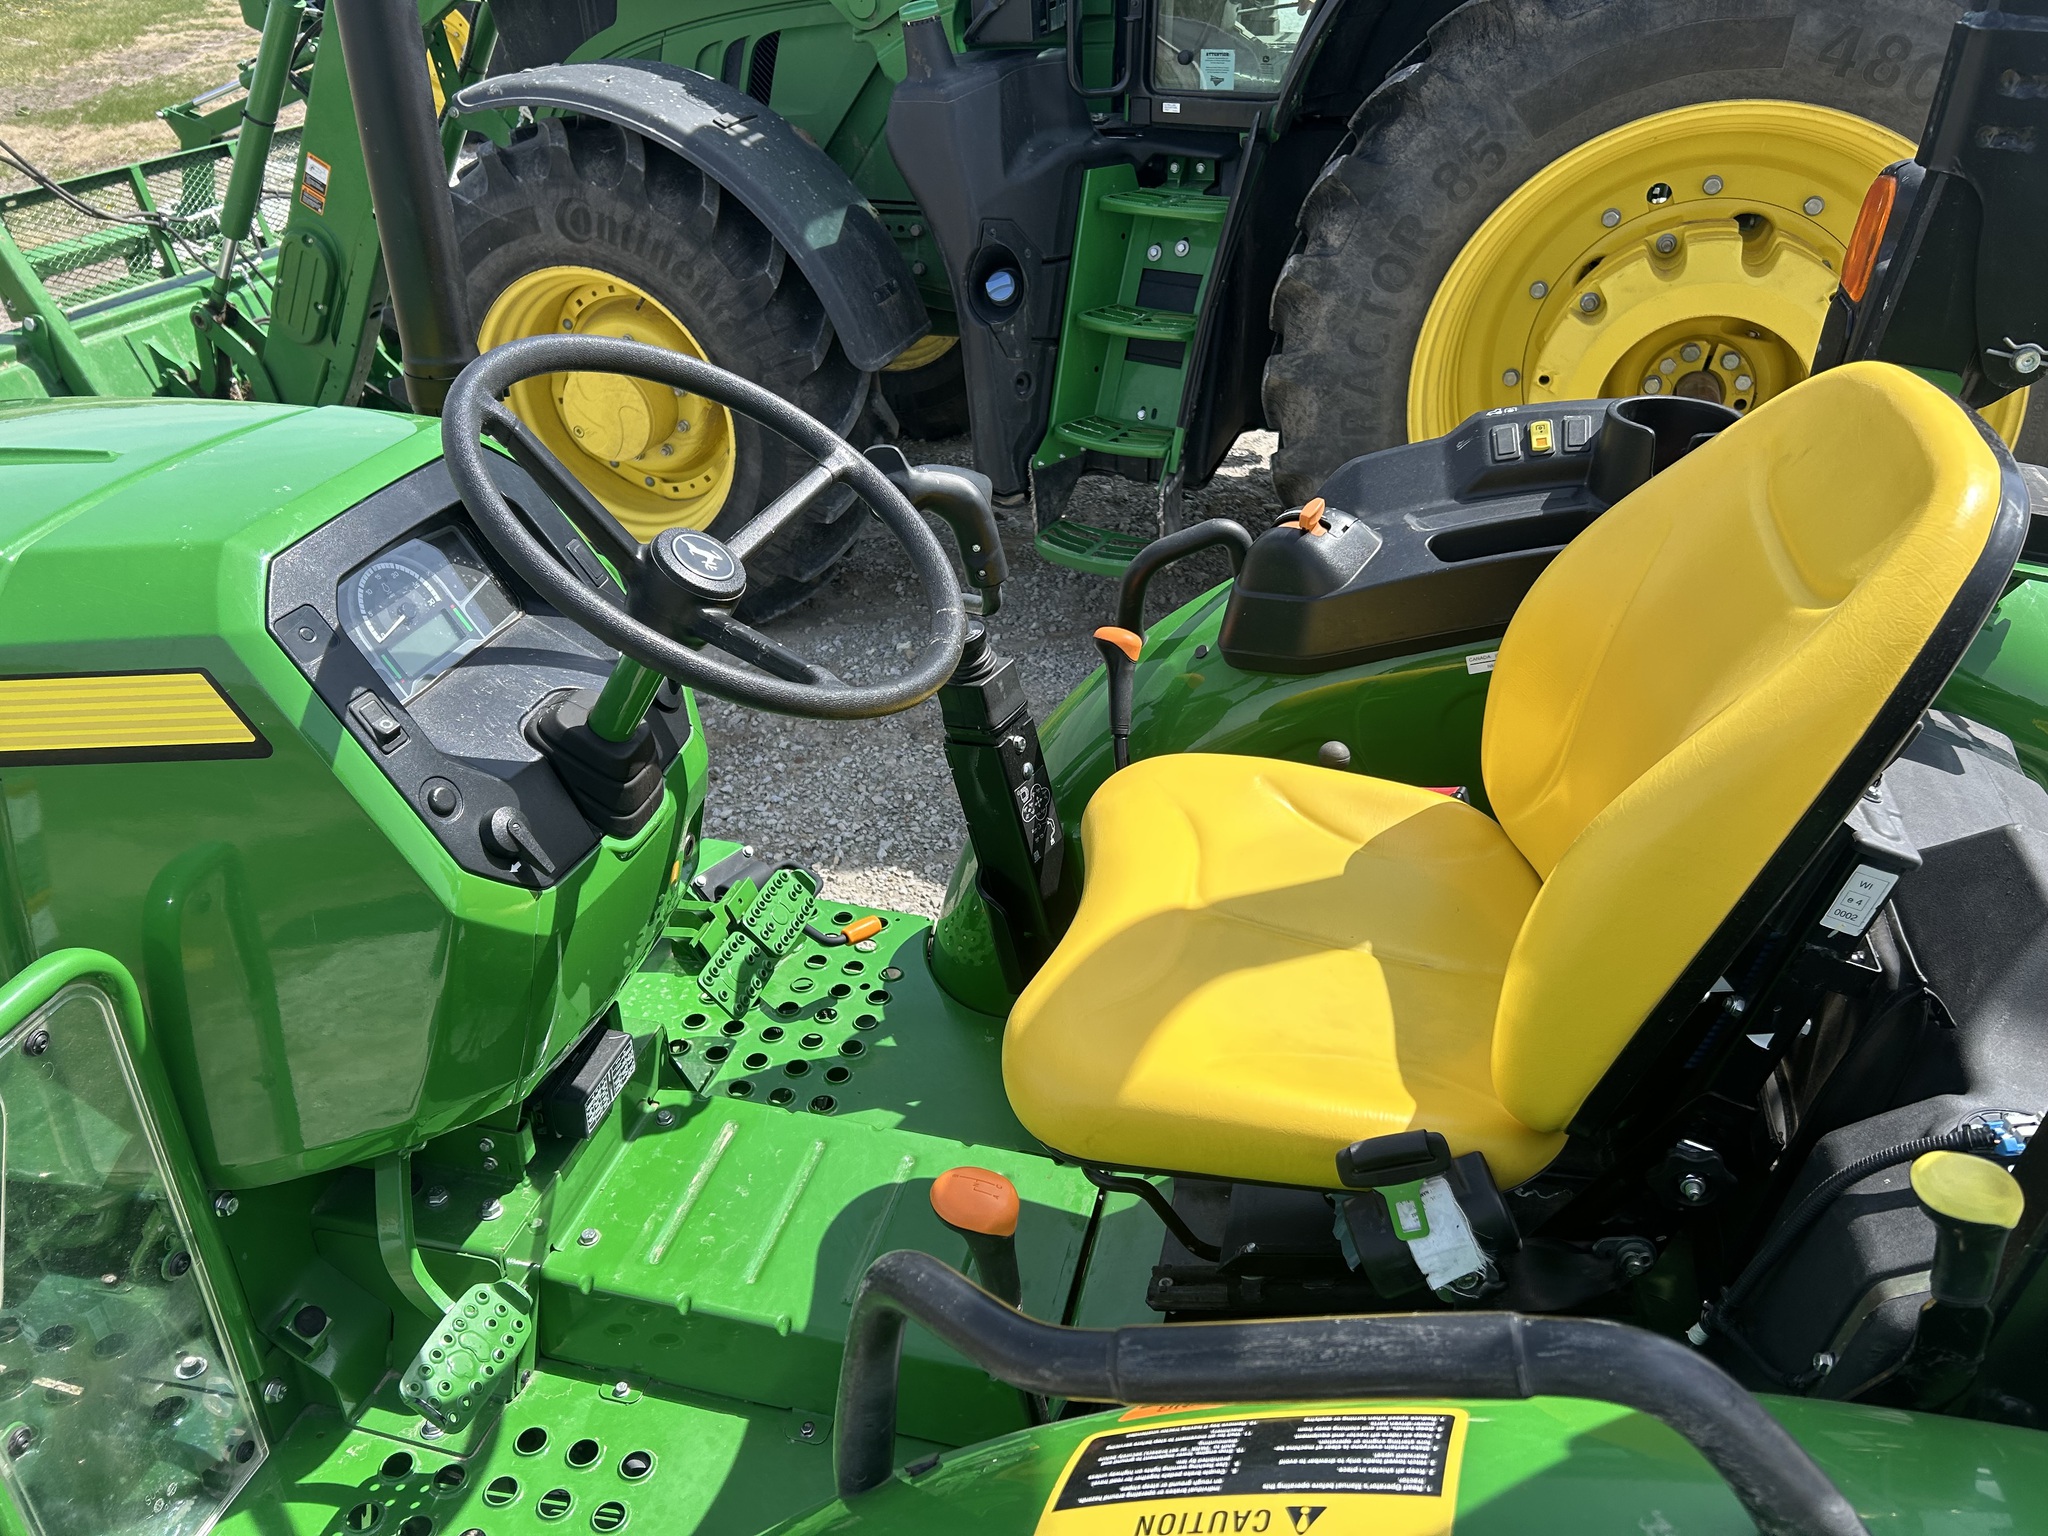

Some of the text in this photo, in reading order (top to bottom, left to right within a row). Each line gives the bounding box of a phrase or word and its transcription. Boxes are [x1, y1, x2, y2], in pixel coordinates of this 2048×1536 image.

[1432, 124, 1508, 205] 85
[1834, 909, 1858, 921] 0002
[1134, 1509, 1271, 1536] CAUTION
